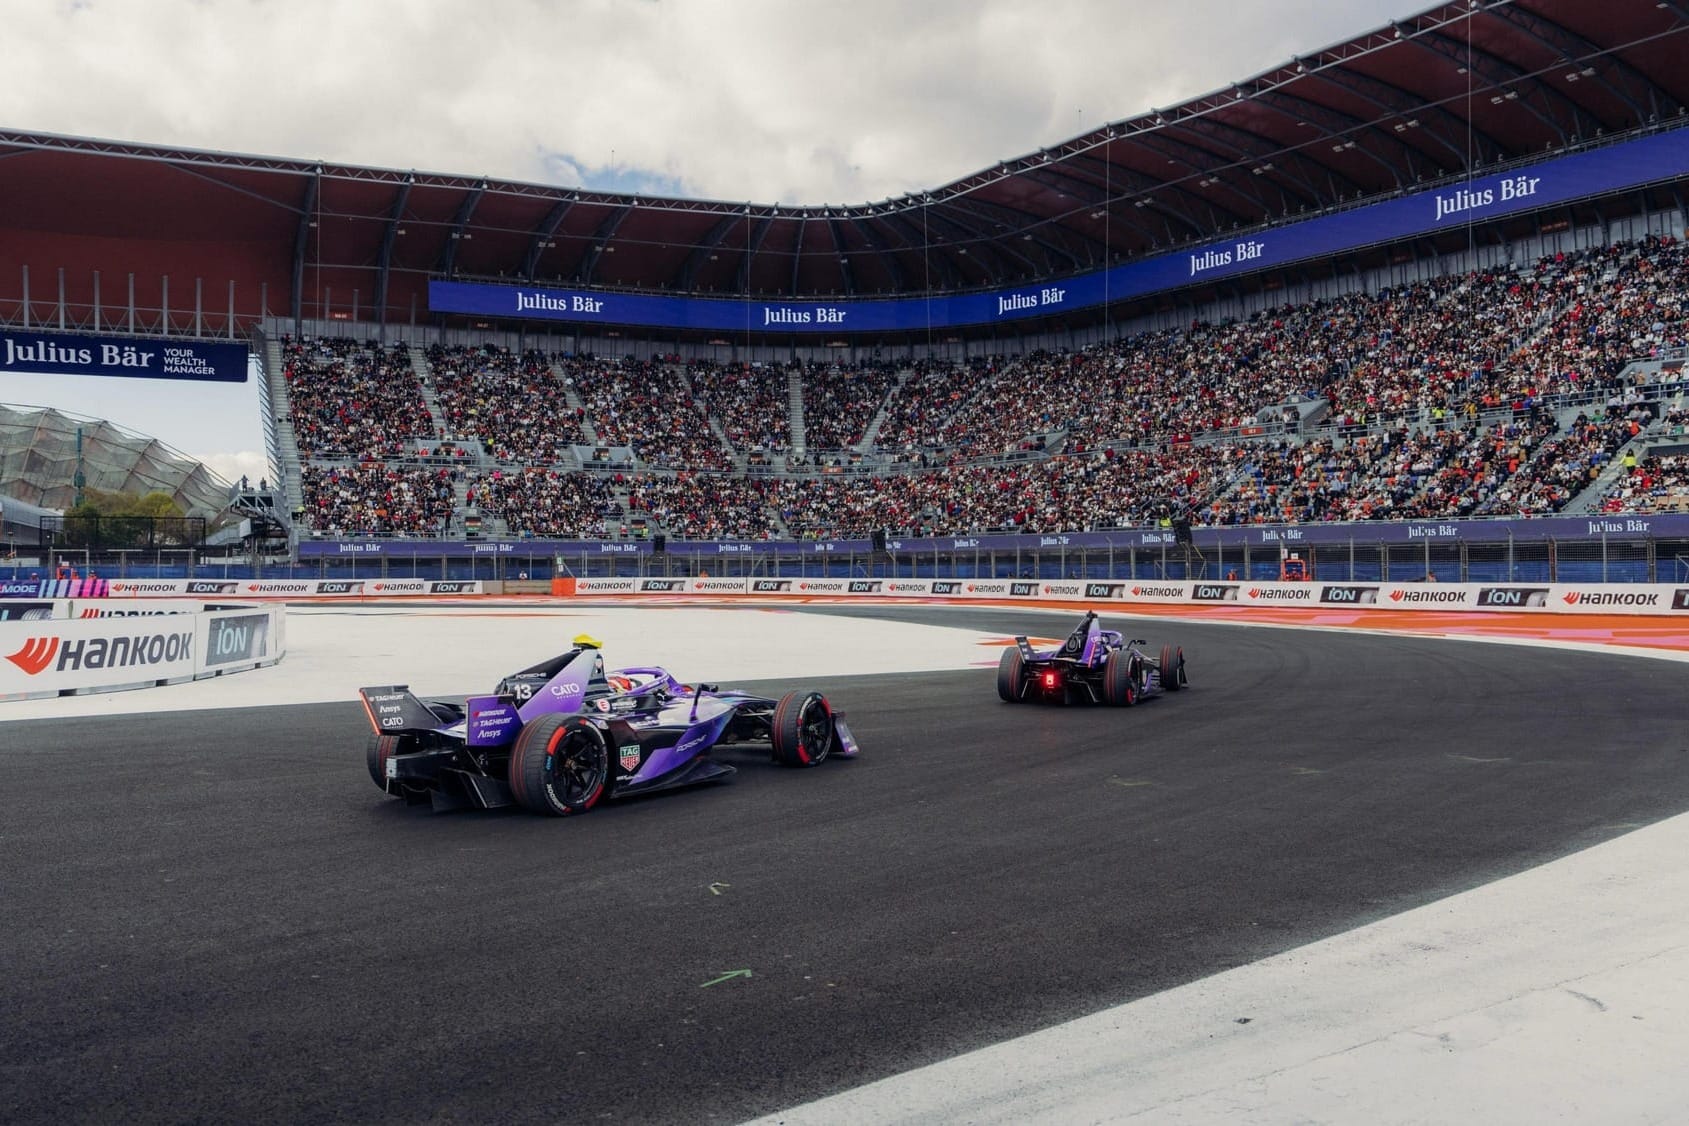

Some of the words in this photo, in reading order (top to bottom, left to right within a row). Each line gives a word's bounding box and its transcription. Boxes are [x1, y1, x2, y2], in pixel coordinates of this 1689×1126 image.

[1435, 189, 1493, 221] Julius
[1500, 175, 1541, 201] Bär
[1190, 250, 1232, 277] Julius
[1236, 241, 1264, 262] Bär
[517, 292, 567, 311] Julius
[572, 296, 603, 313] Bär
[998, 293, 1038, 316] Julius
[1041, 287, 1066, 305] Bär
[764, 307, 811, 326] Julius
[816, 307, 847, 323] Bär
[5, 338, 92, 365] Julius
[101, 344, 155, 367] Bär
[163, 348, 193, 358] YOUR
[163, 357, 206, 367] WEALTH
[163, 365, 215, 376] MANAGER
[1439, 525, 1458, 536] Bär
[1589, 521, 1623, 535] Julius
[1627, 519, 1650, 532] Bär
[1287, 529, 1303, 540] Bär
[340, 543, 363, 553] Julius
[366, 543, 381, 552] Bär
[2, 585, 37, 593] MODE
[383, 583, 424, 591] HanKOO
[514, 684, 532, 700] 13
[551, 682, 580, 696] CATO
[379, 705, 401, 713] Ansys
[382, 716, 404, 726] CATO
[477, 729, 502, 739] Ansys
[622, 746, 640, 756] TAG
[621, 756, 640, 768] HEUER
